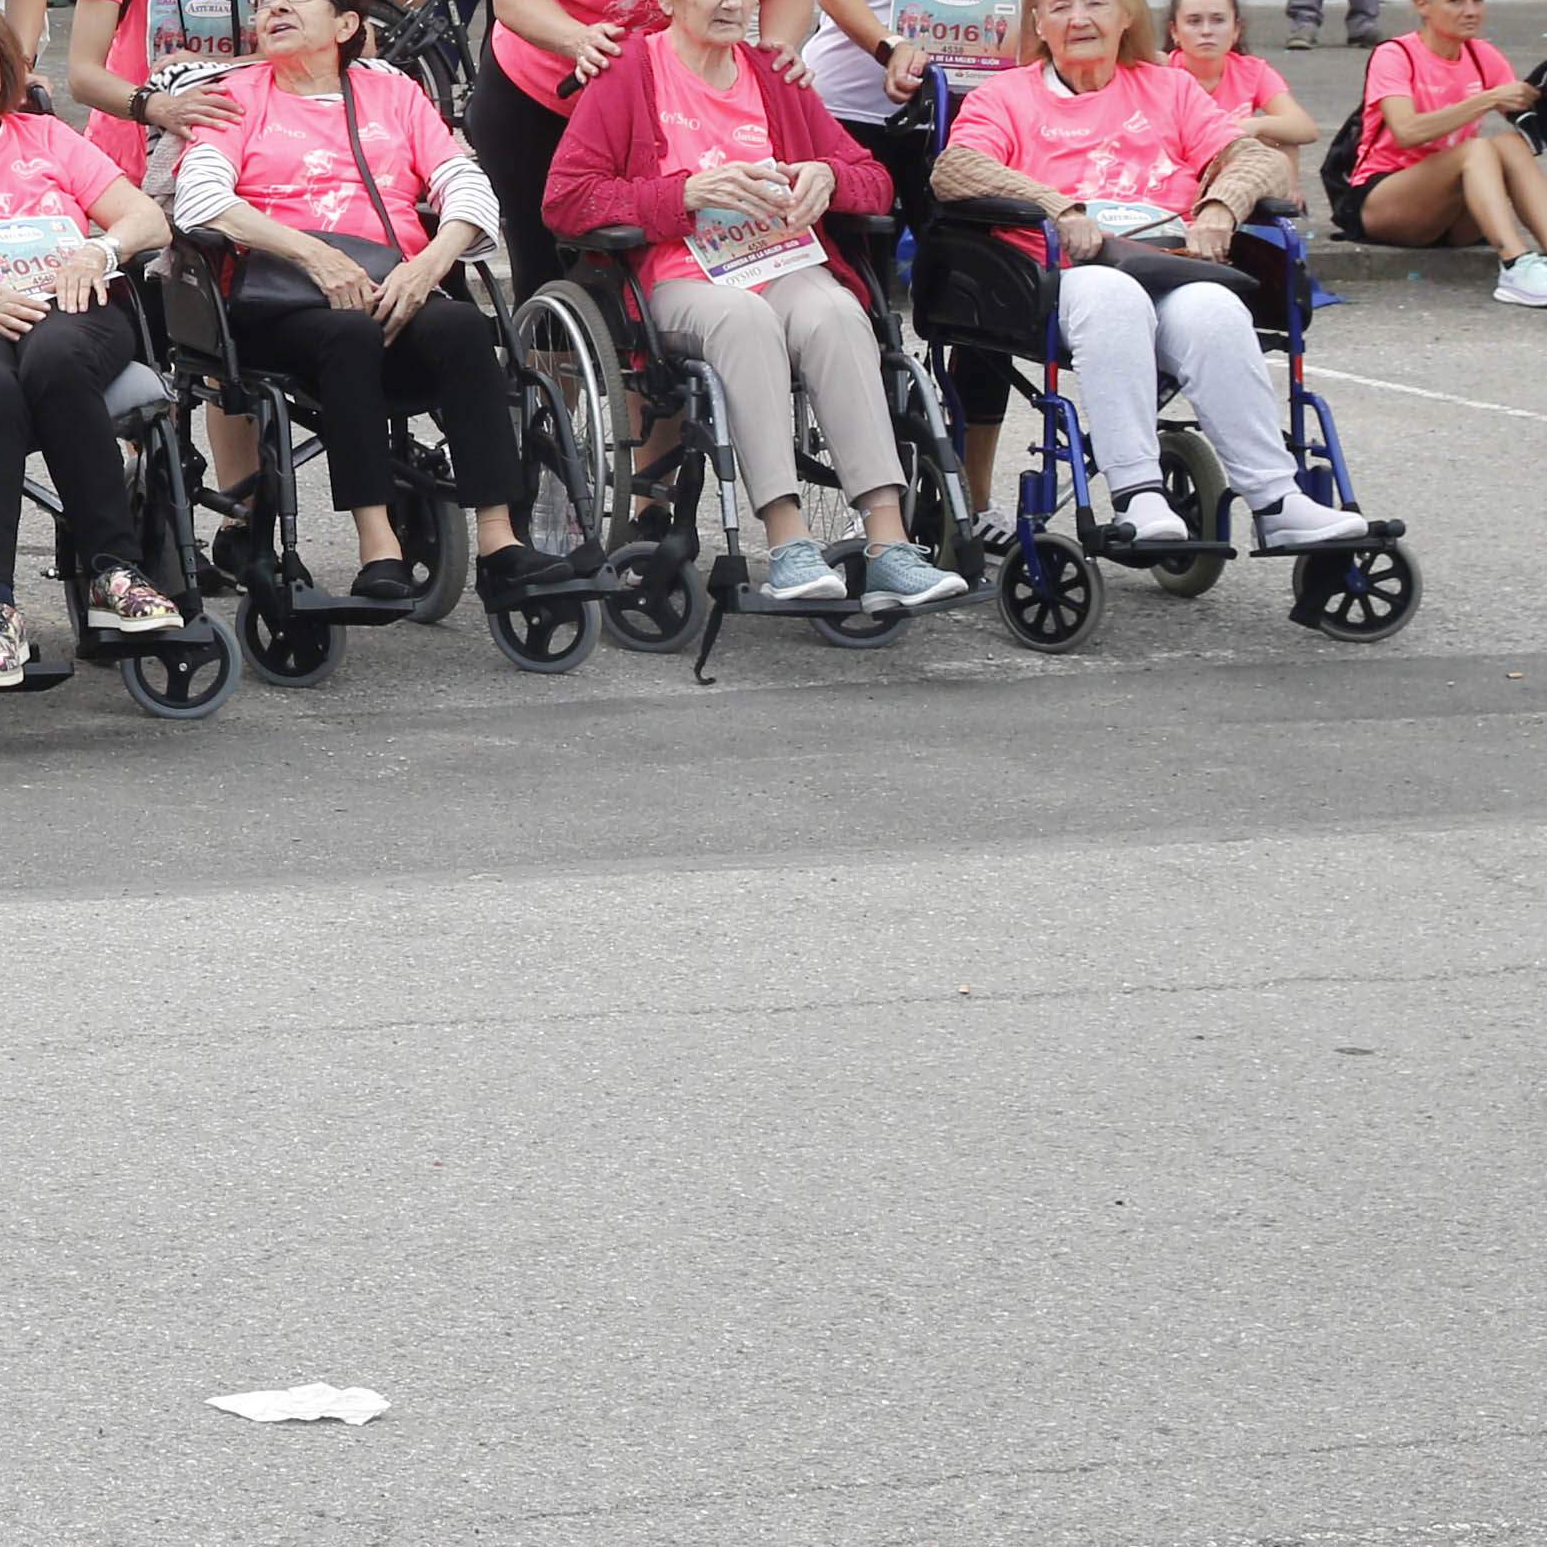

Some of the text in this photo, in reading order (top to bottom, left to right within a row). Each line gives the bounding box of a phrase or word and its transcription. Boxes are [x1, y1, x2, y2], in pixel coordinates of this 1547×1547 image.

[932, 22, 980, 42] 016
[188, 35, 233, 54] 016
[12, 253, 62, 275] 016
[725, 266, 763, 287] OYSHO
